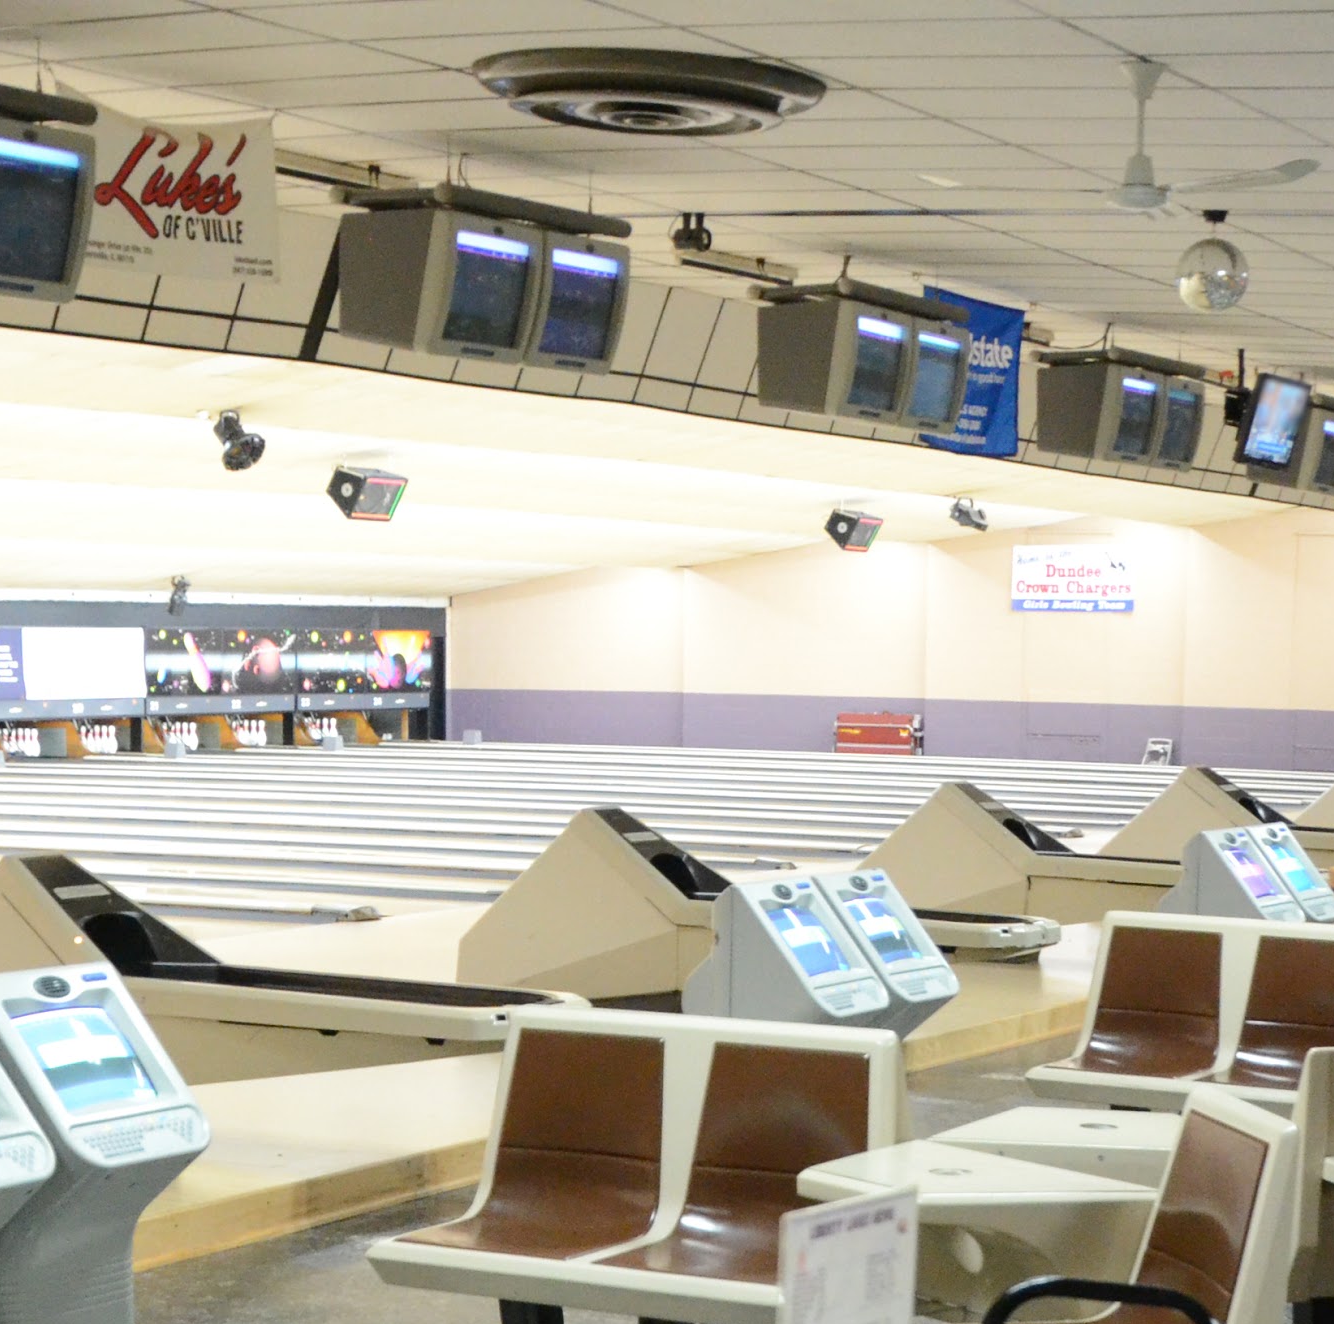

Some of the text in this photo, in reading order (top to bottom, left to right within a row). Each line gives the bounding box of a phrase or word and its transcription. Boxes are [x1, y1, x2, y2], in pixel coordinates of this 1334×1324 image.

[94, 127, 247, 239] Luke's
[163, 215, 243, 244] OF C'VILLE
[968, 332, 1013, 369] lstate
[1045, 564, 1101, 578] Dundee
[1016, 580, 1131, 597] Crown Chargers
